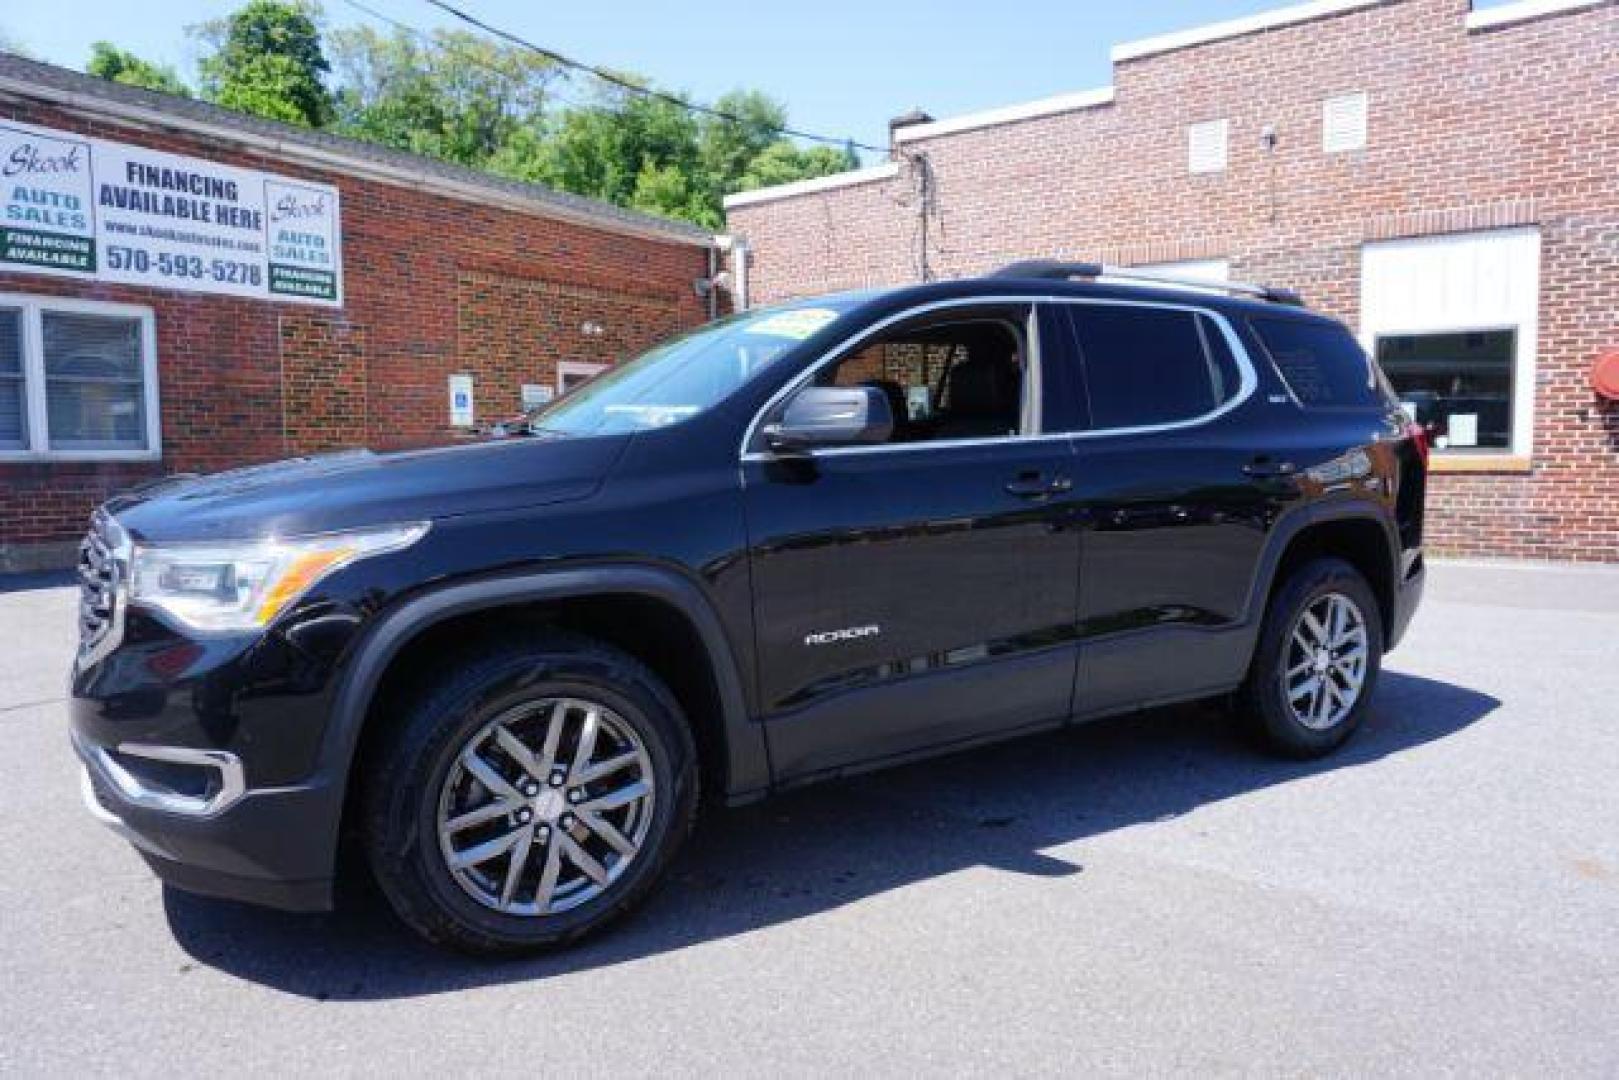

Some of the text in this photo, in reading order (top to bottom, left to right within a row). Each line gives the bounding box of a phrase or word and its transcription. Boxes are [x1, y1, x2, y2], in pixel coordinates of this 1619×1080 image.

[126, 161, 239, 202] FINANCING
[12, 185, 81, 211] AUTO
[100, 183, 262, 230] AVAILABLE HERE
[6, 203, 87, 229] SALES
[277, 229, 325, 249] AUTO
[272, 244, 330, 264] SALES
[804, 624, 880, 646] ACADIA
